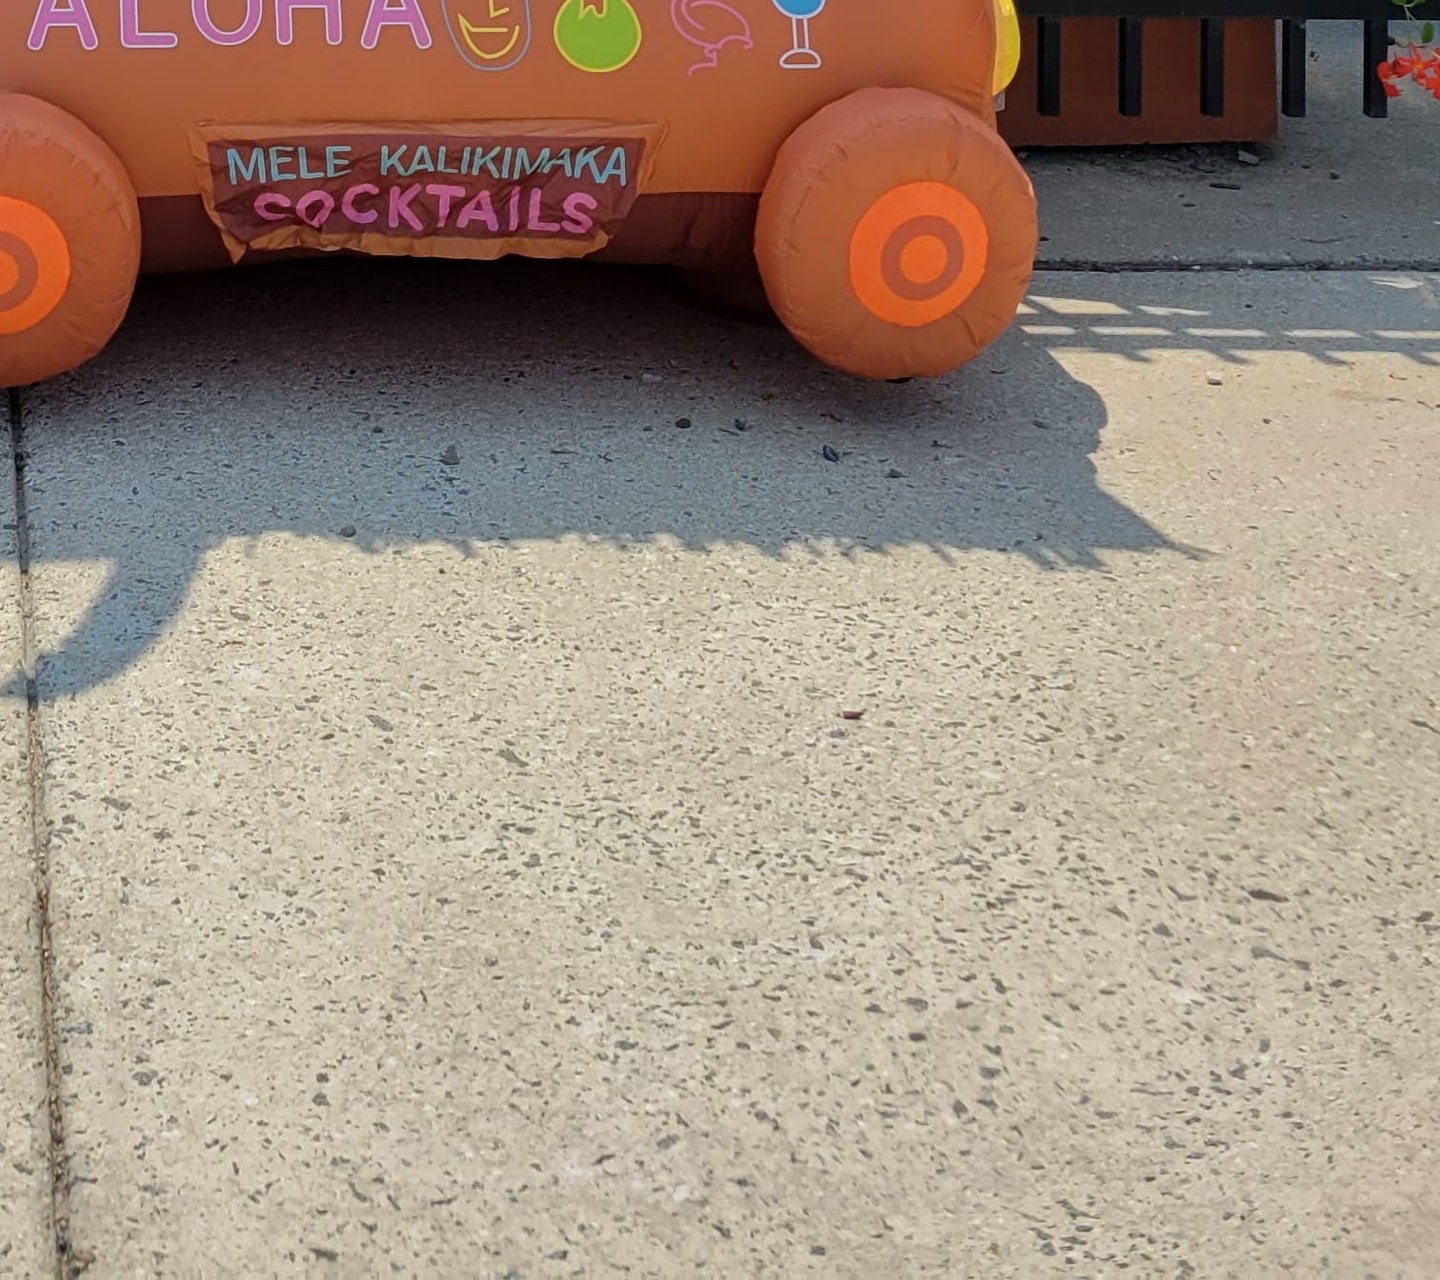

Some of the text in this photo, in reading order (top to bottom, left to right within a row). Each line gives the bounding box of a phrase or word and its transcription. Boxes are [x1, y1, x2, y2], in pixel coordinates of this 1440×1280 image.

[226, 144, 628, 187] MELE KALIKIMAKA
[253, 183, 598, 234] COCKTAILS
